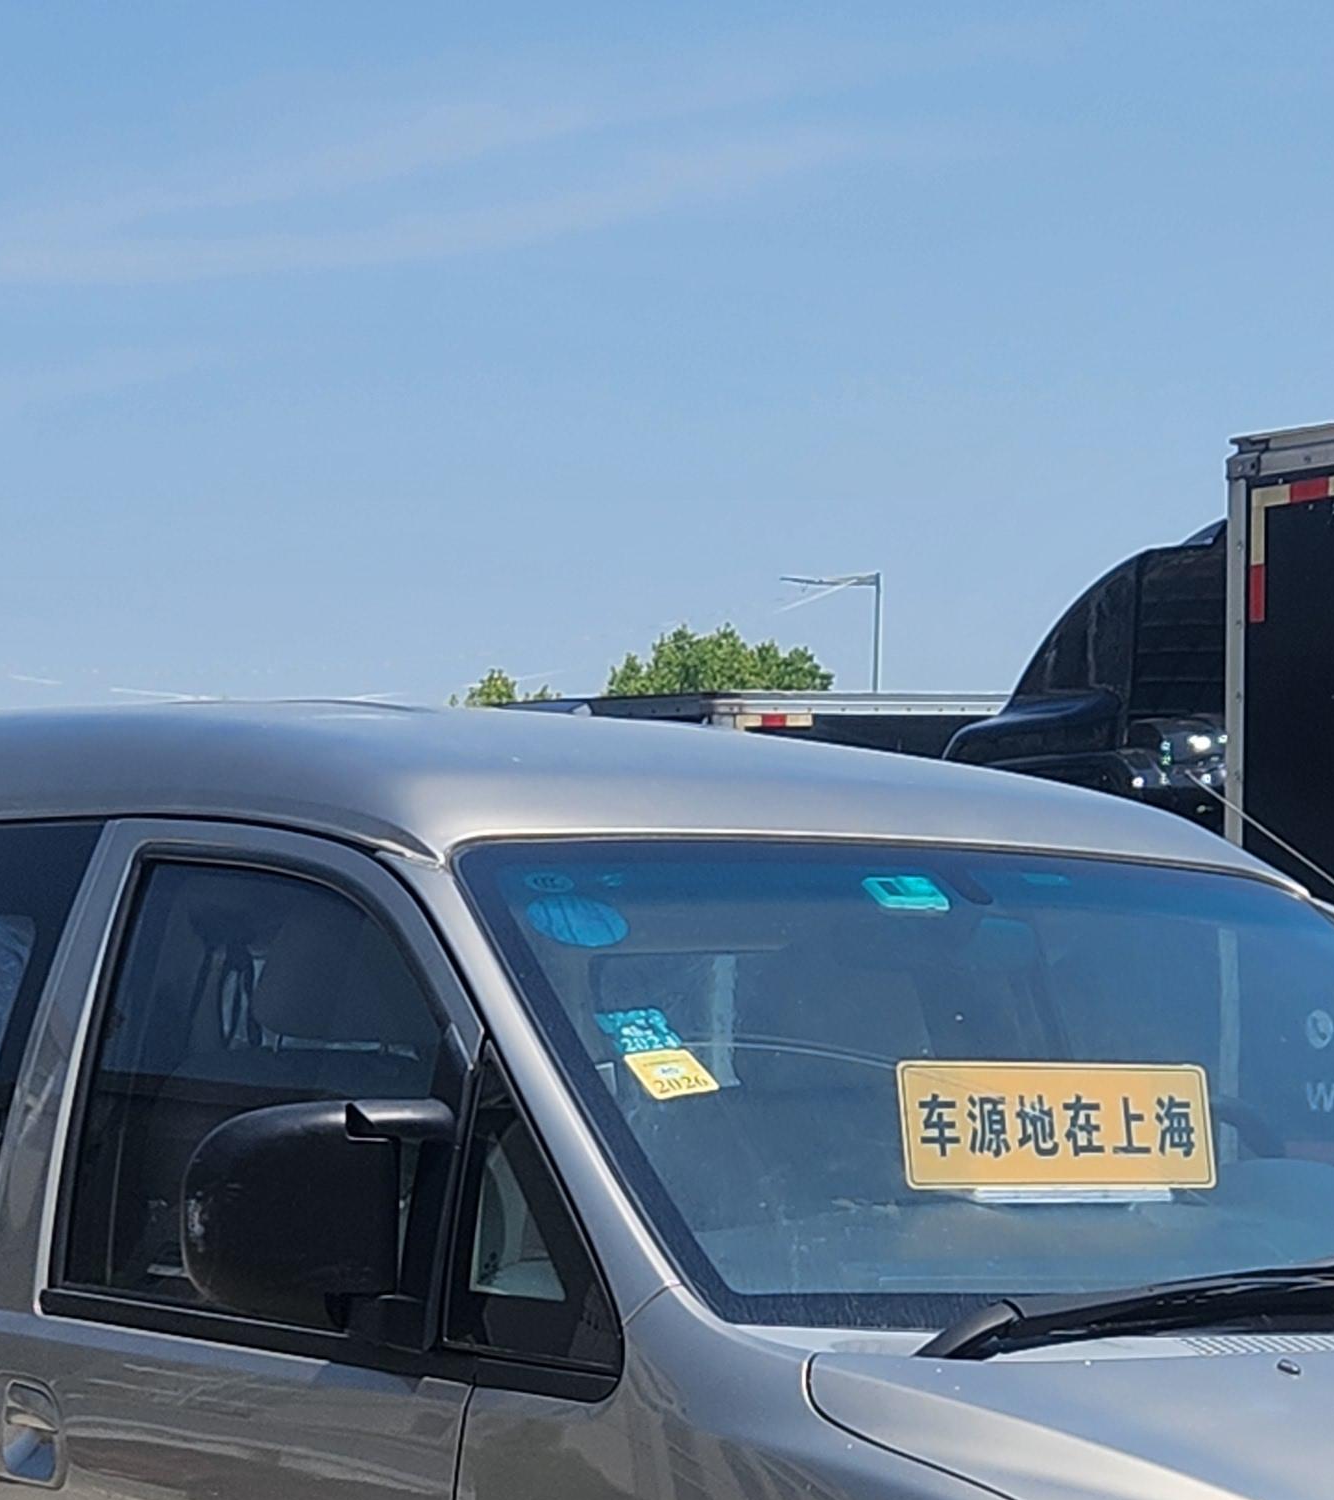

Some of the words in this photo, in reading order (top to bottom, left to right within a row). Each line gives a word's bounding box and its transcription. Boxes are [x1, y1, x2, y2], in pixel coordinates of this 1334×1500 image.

[653, 1075, 708, 1094] 2026
[918, 1094, 1195, 1158] 车源地在上海
